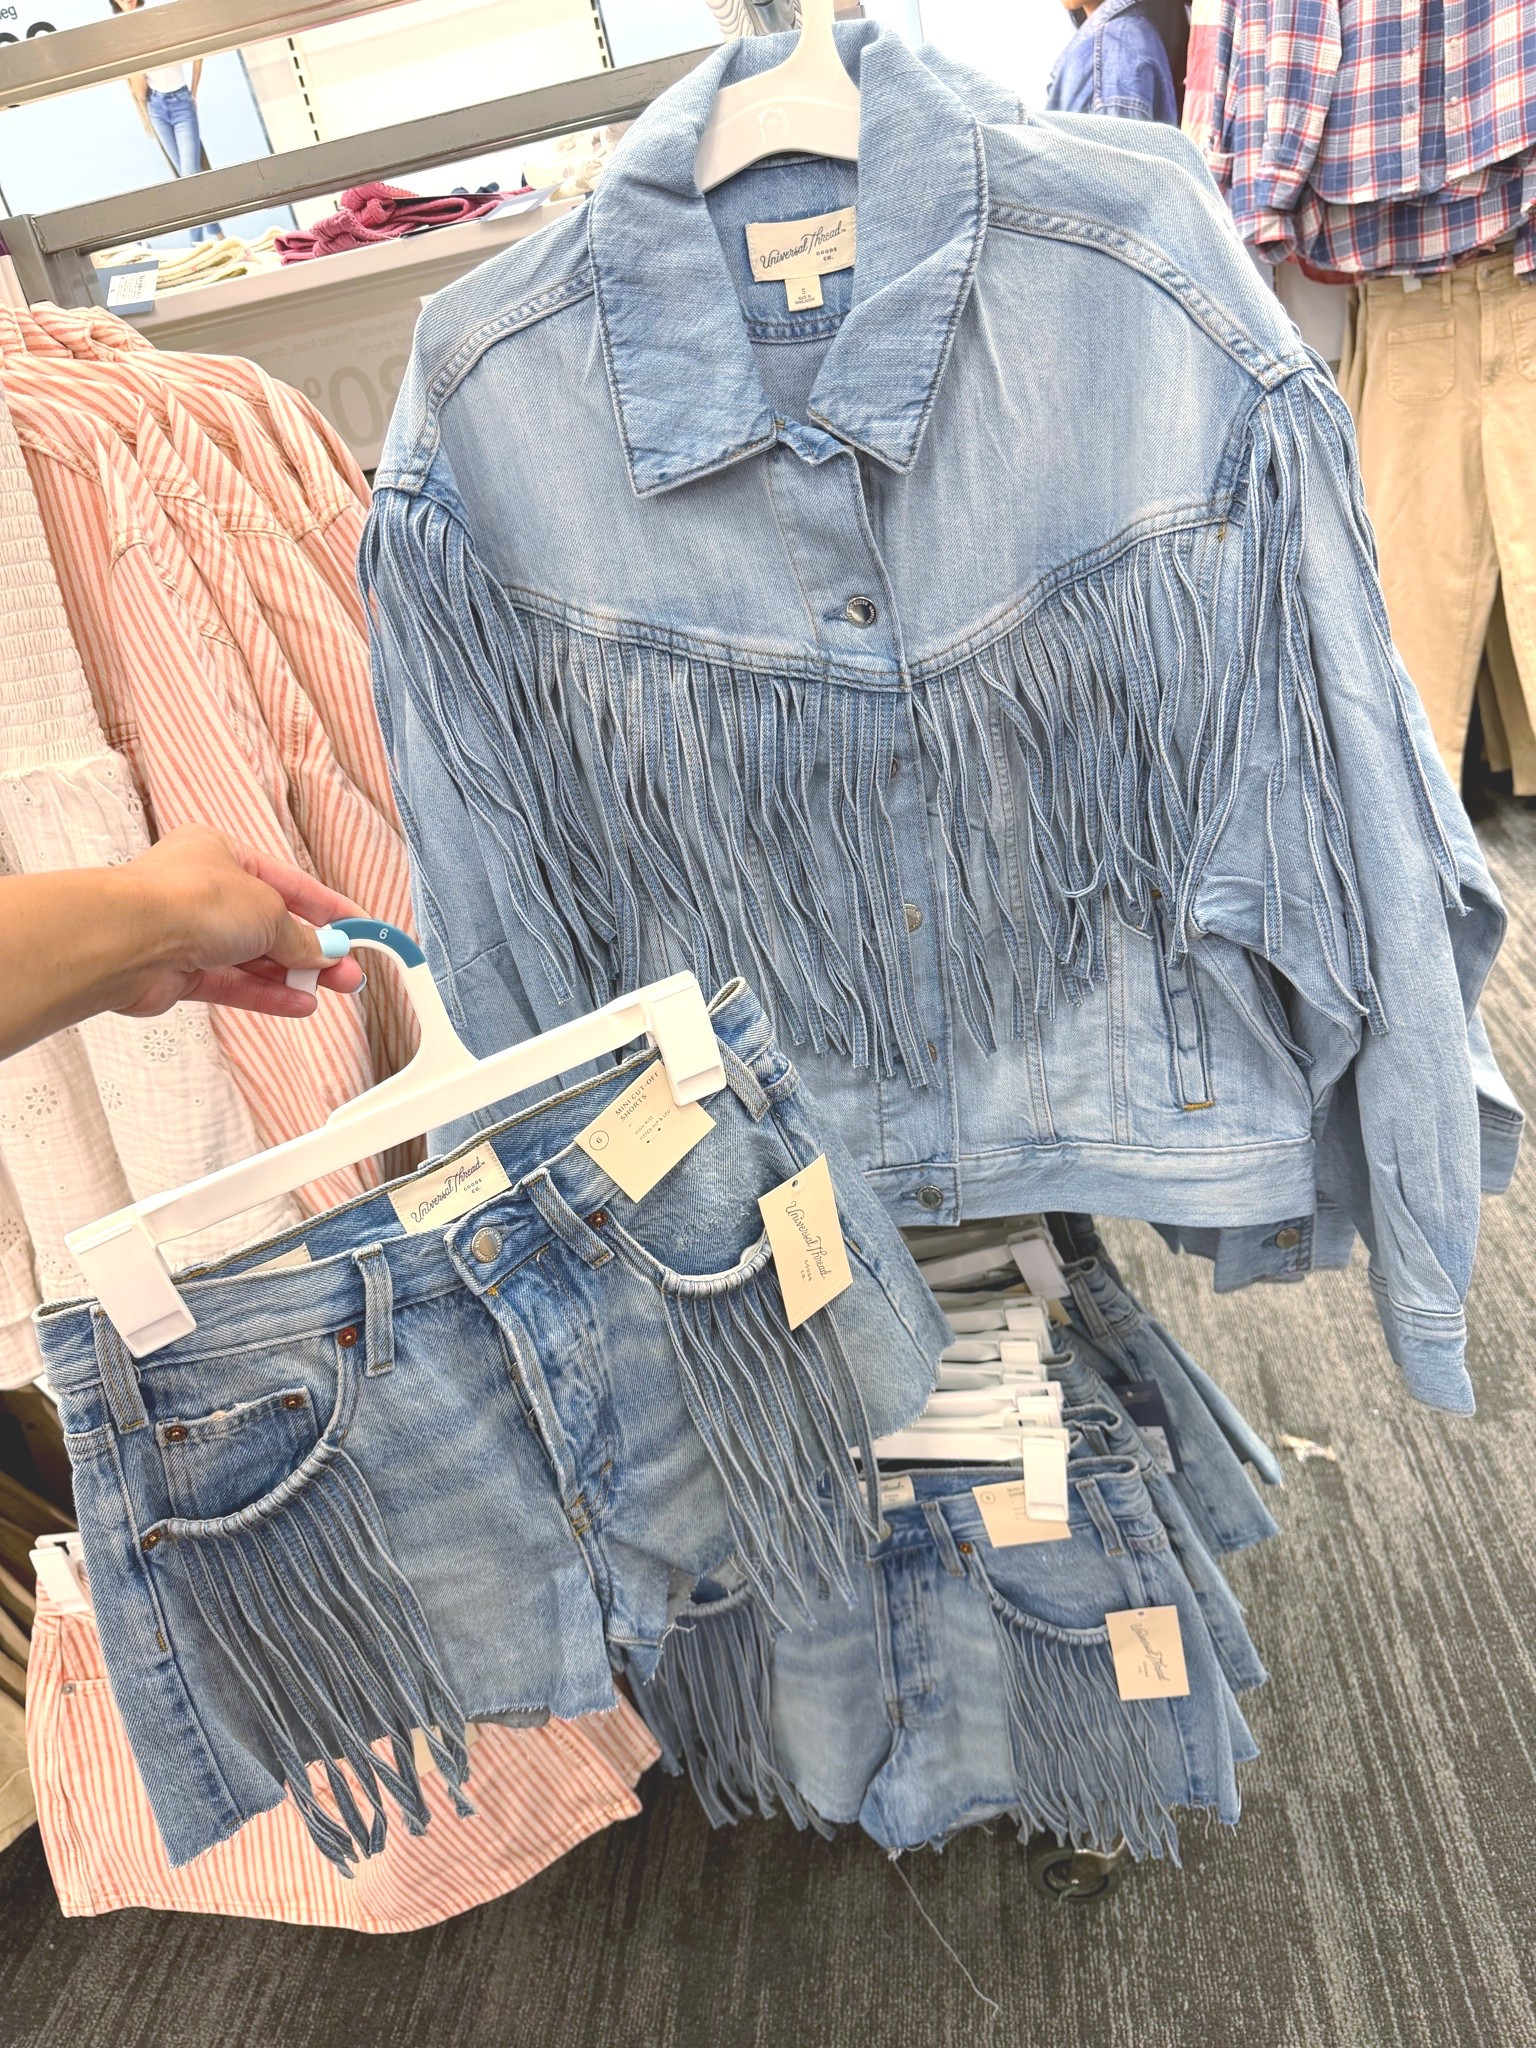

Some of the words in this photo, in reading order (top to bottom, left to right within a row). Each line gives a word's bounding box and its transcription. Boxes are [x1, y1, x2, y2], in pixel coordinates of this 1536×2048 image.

[0, 5, 18, 20] eg
[760, 236, 808, 269] Universal
[801, 220, 842, 254] Thread
[379, 928, 389, 939] 6
[615, 1100, 632, 1116] MINI
[632, 1071, 660, 1100] CUT-OFF
[620, 1094, 647, 1122] SHORTS
[411, 1181, 454, 1223] Universal
[444, 1156, 482, 1193] Thread
[785, 1201, 818, 1247] Universal
[806, 1235, 832, 1278] Thread
